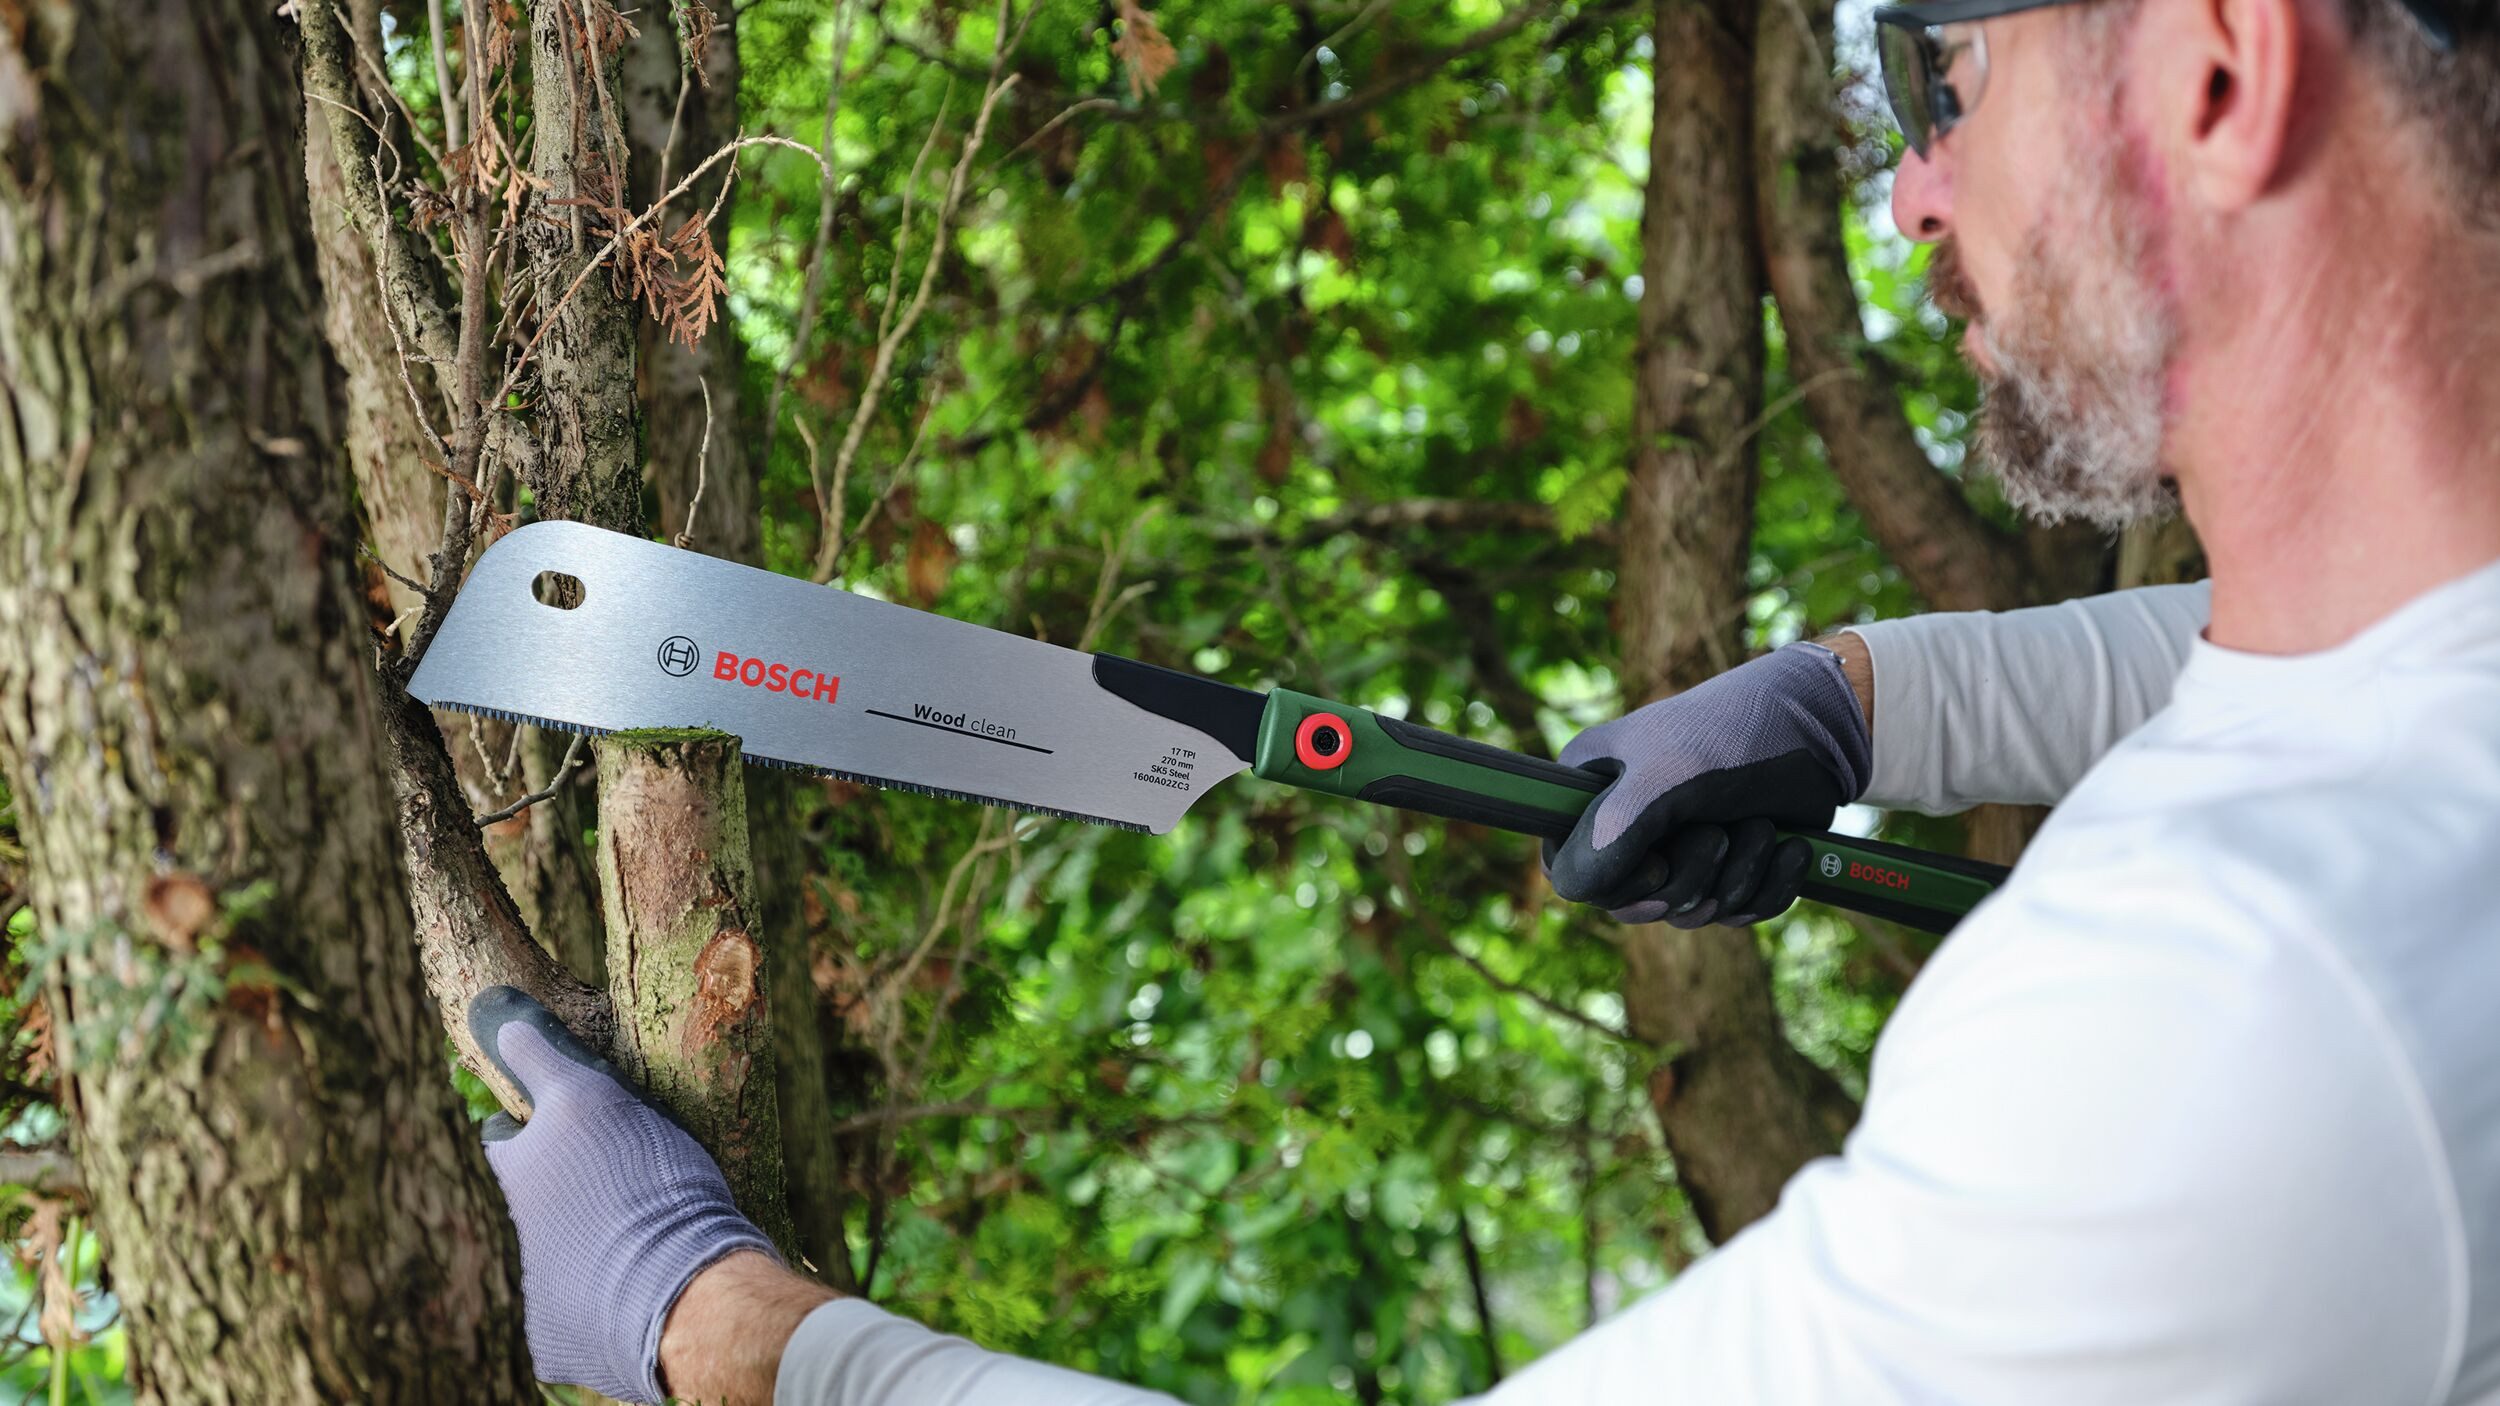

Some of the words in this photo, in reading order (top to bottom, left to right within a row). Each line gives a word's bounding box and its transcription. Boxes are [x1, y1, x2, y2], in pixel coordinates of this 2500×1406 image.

[713, 651, 840, 704] BOSCH
[914, 703, 966, 728] Wood
[970, 717, 1017, 740] clean
[1161, 756, 1177, 766] 270
[1178, 761, 1194, 770] mm
[1171, 747, 1181, 756] 17
[1183, 749, 1196, 759] TPI
[1133, 771, 1190, 791] 1600A02ZC3
[1151, 764, 1168, 775] SK5
[1169, 768, 1190, 780] Steel
[1849, 862, 1910, 890] BOSCH
